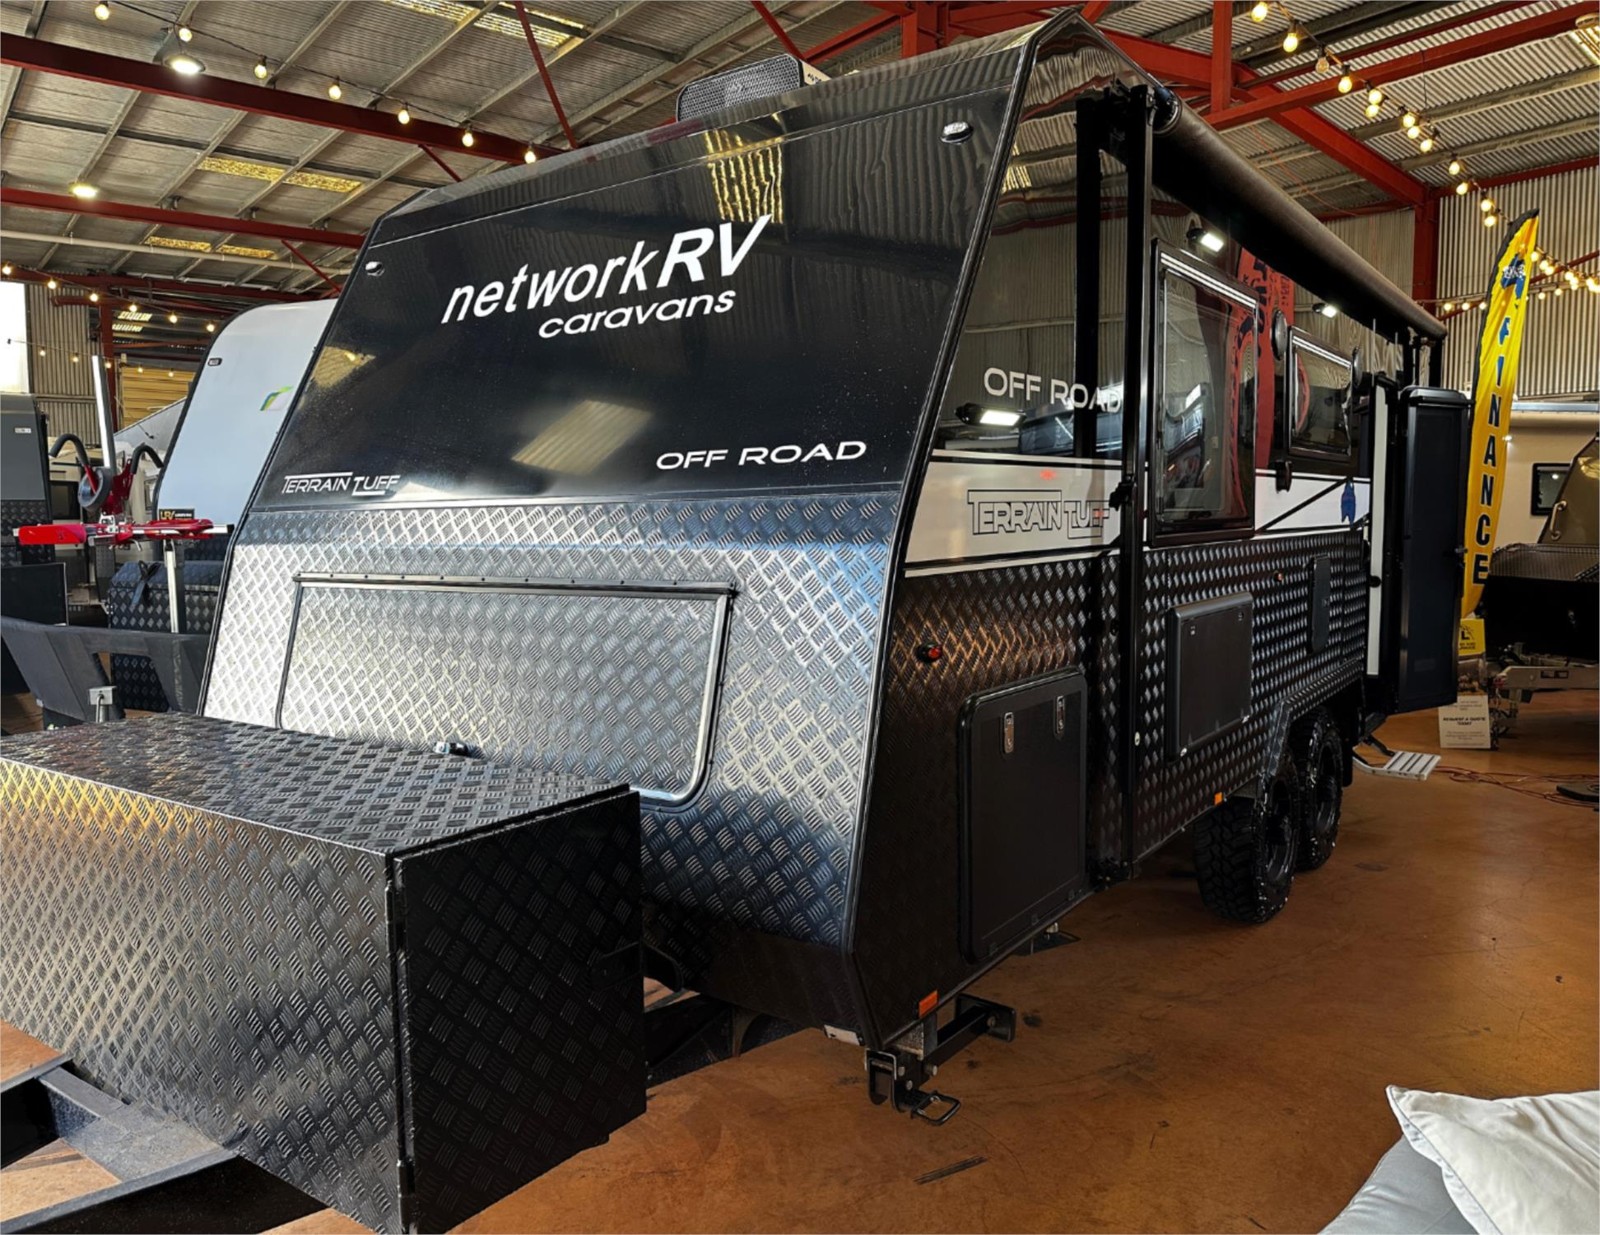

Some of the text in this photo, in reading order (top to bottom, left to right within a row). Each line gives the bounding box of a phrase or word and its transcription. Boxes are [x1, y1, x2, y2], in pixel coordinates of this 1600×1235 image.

[441, 213, 773, 324] networkRV
[538, 290, 736, 338] caravans
[984, 367, 1122, 413] OFF ROAD
[656, 440, 867, 470] OFF ROAD
[1472, 317, 1511, 584] FINANCE
[281, 472, 401, 496] TERRAIN TUFF
[968, 489, 1110, 540] TERRAIN TUFF
